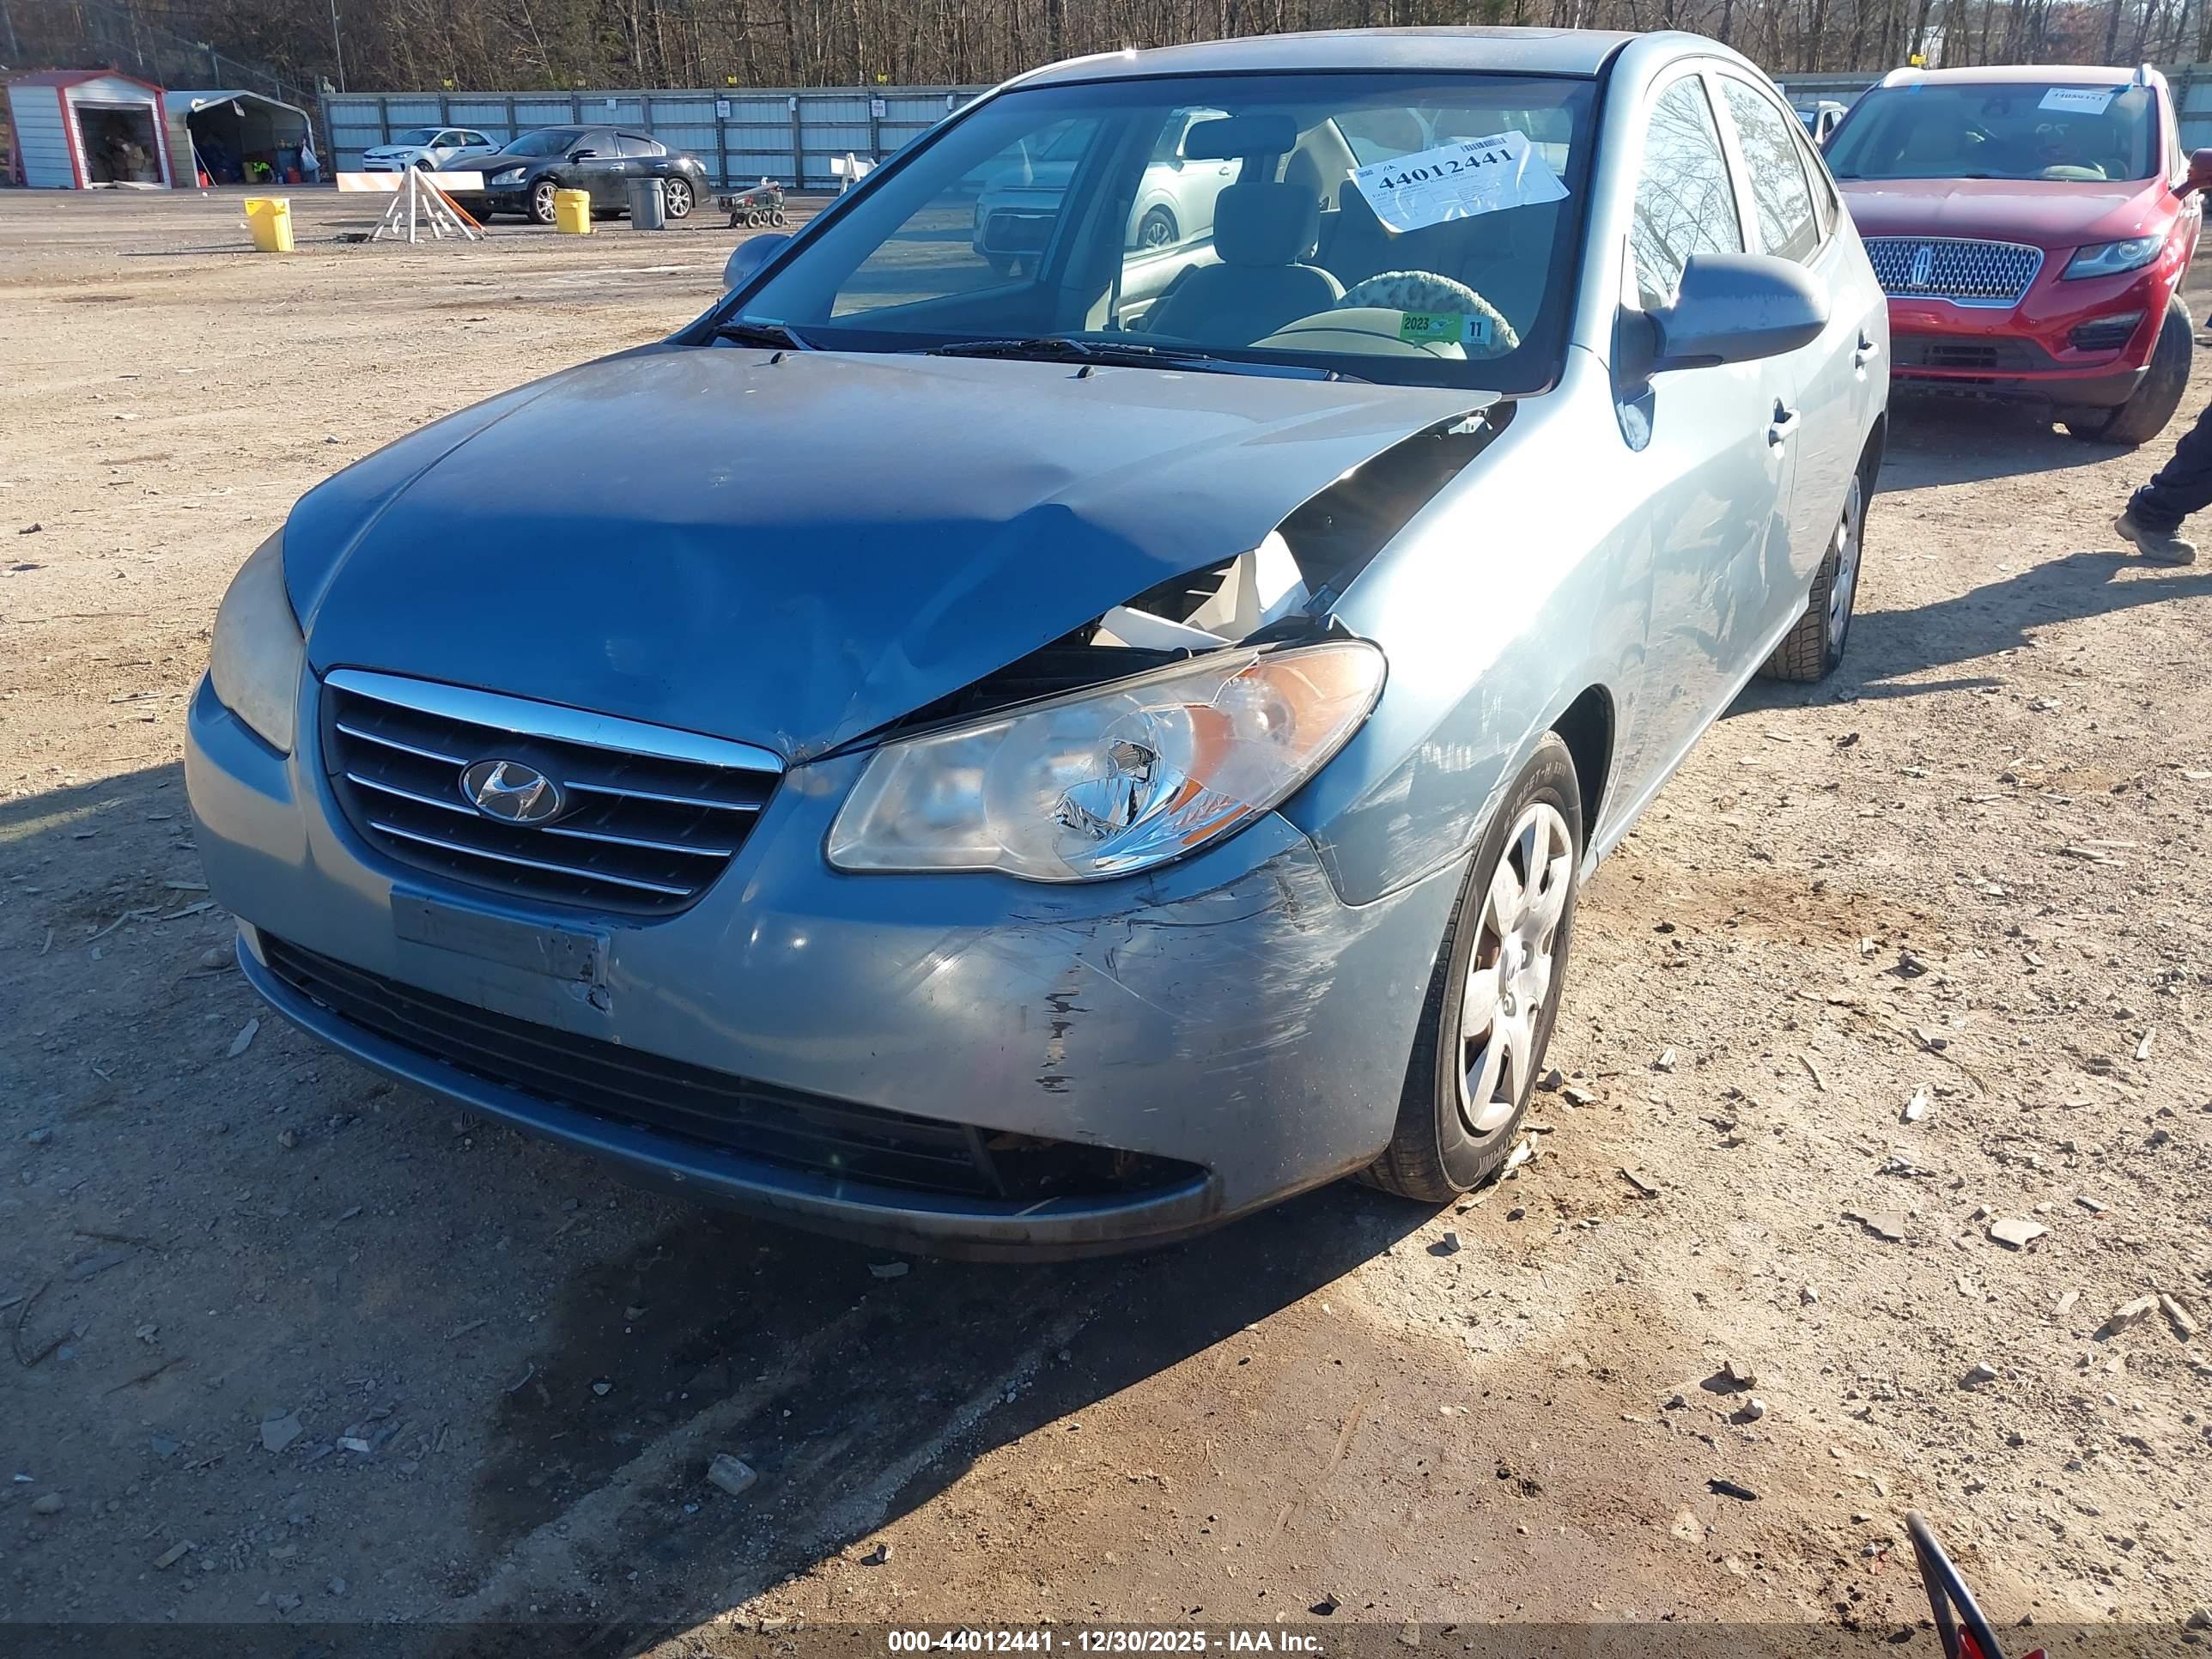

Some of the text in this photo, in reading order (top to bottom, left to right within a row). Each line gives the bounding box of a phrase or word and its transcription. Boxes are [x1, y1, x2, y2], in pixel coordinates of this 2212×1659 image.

[1378, 149, 1516, 190] 44012441
[1403, 317, 1430, 331] 2023
[1469, 322, 1482, 337] 11
